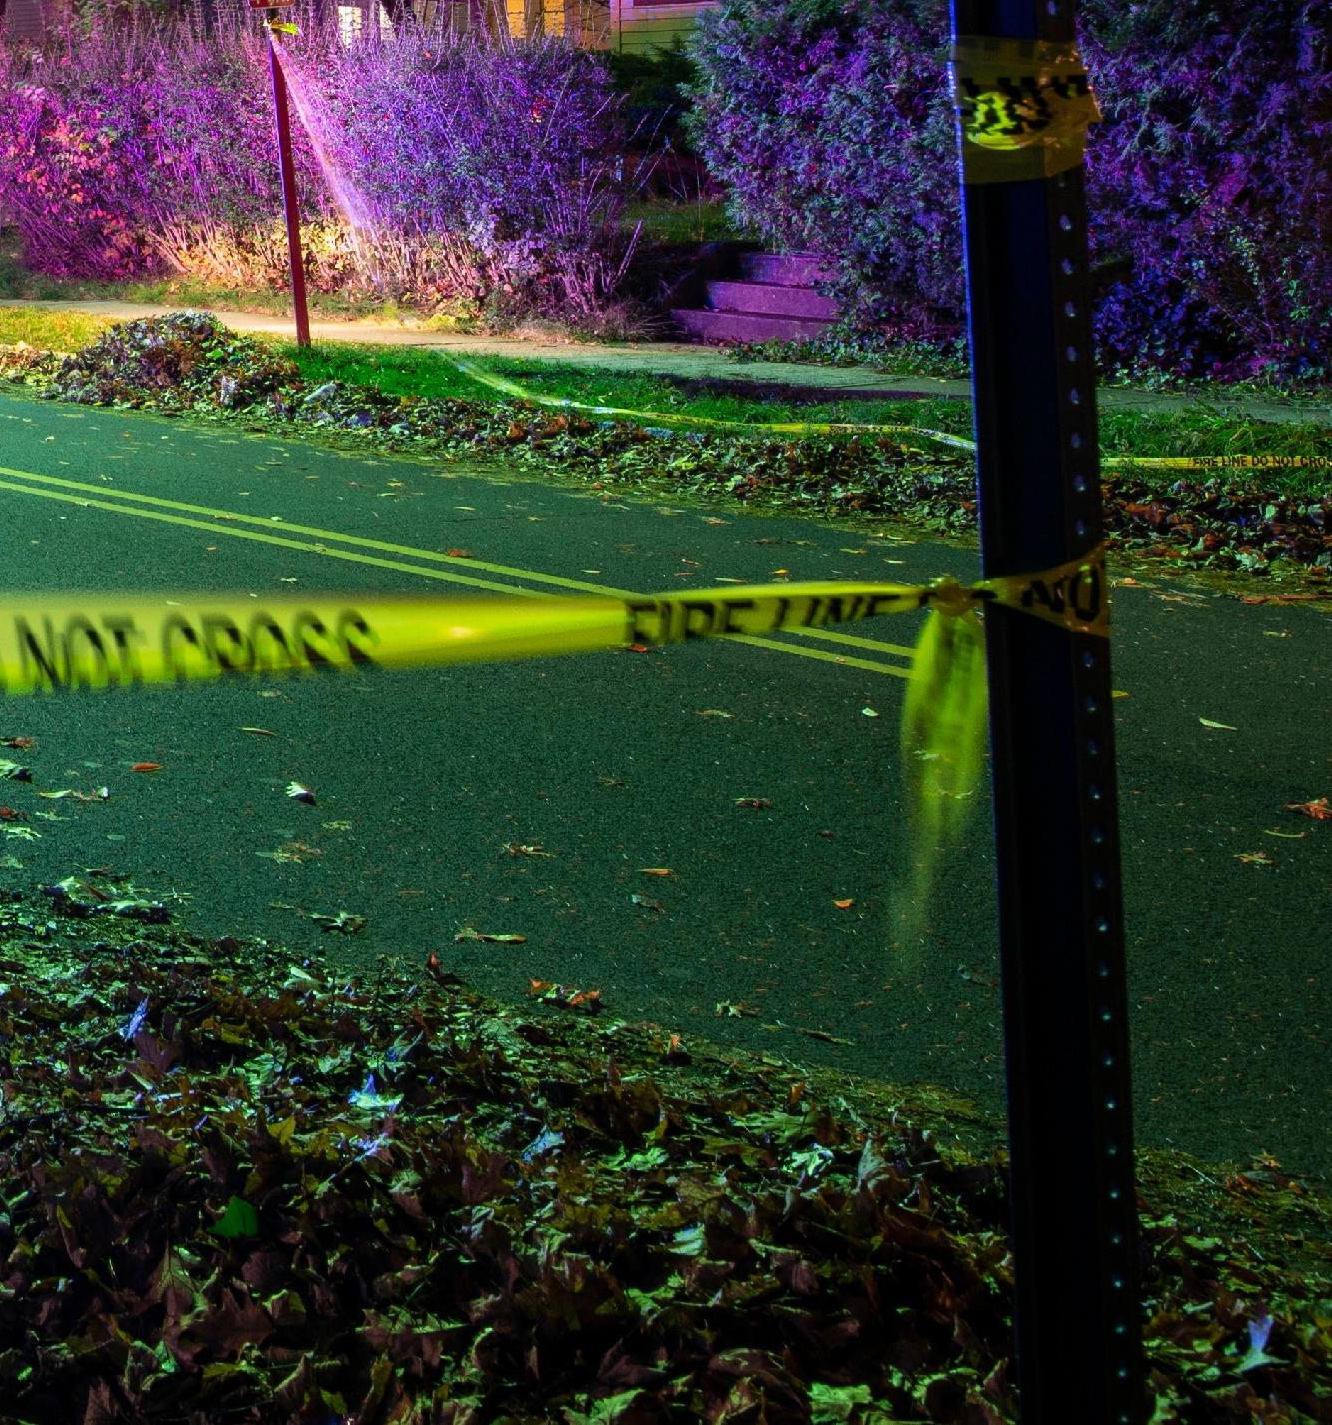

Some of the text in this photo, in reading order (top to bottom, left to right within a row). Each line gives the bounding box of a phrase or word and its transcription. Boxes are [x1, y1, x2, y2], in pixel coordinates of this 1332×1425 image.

[1221, 456, 1249, 467] LINE
[1252, 456, 1269, 466] DO
[1273, 456, 1295, 467] NOT
[14, 613, 142, 687] NOT
[162, 609, 381, 673] CROSS
